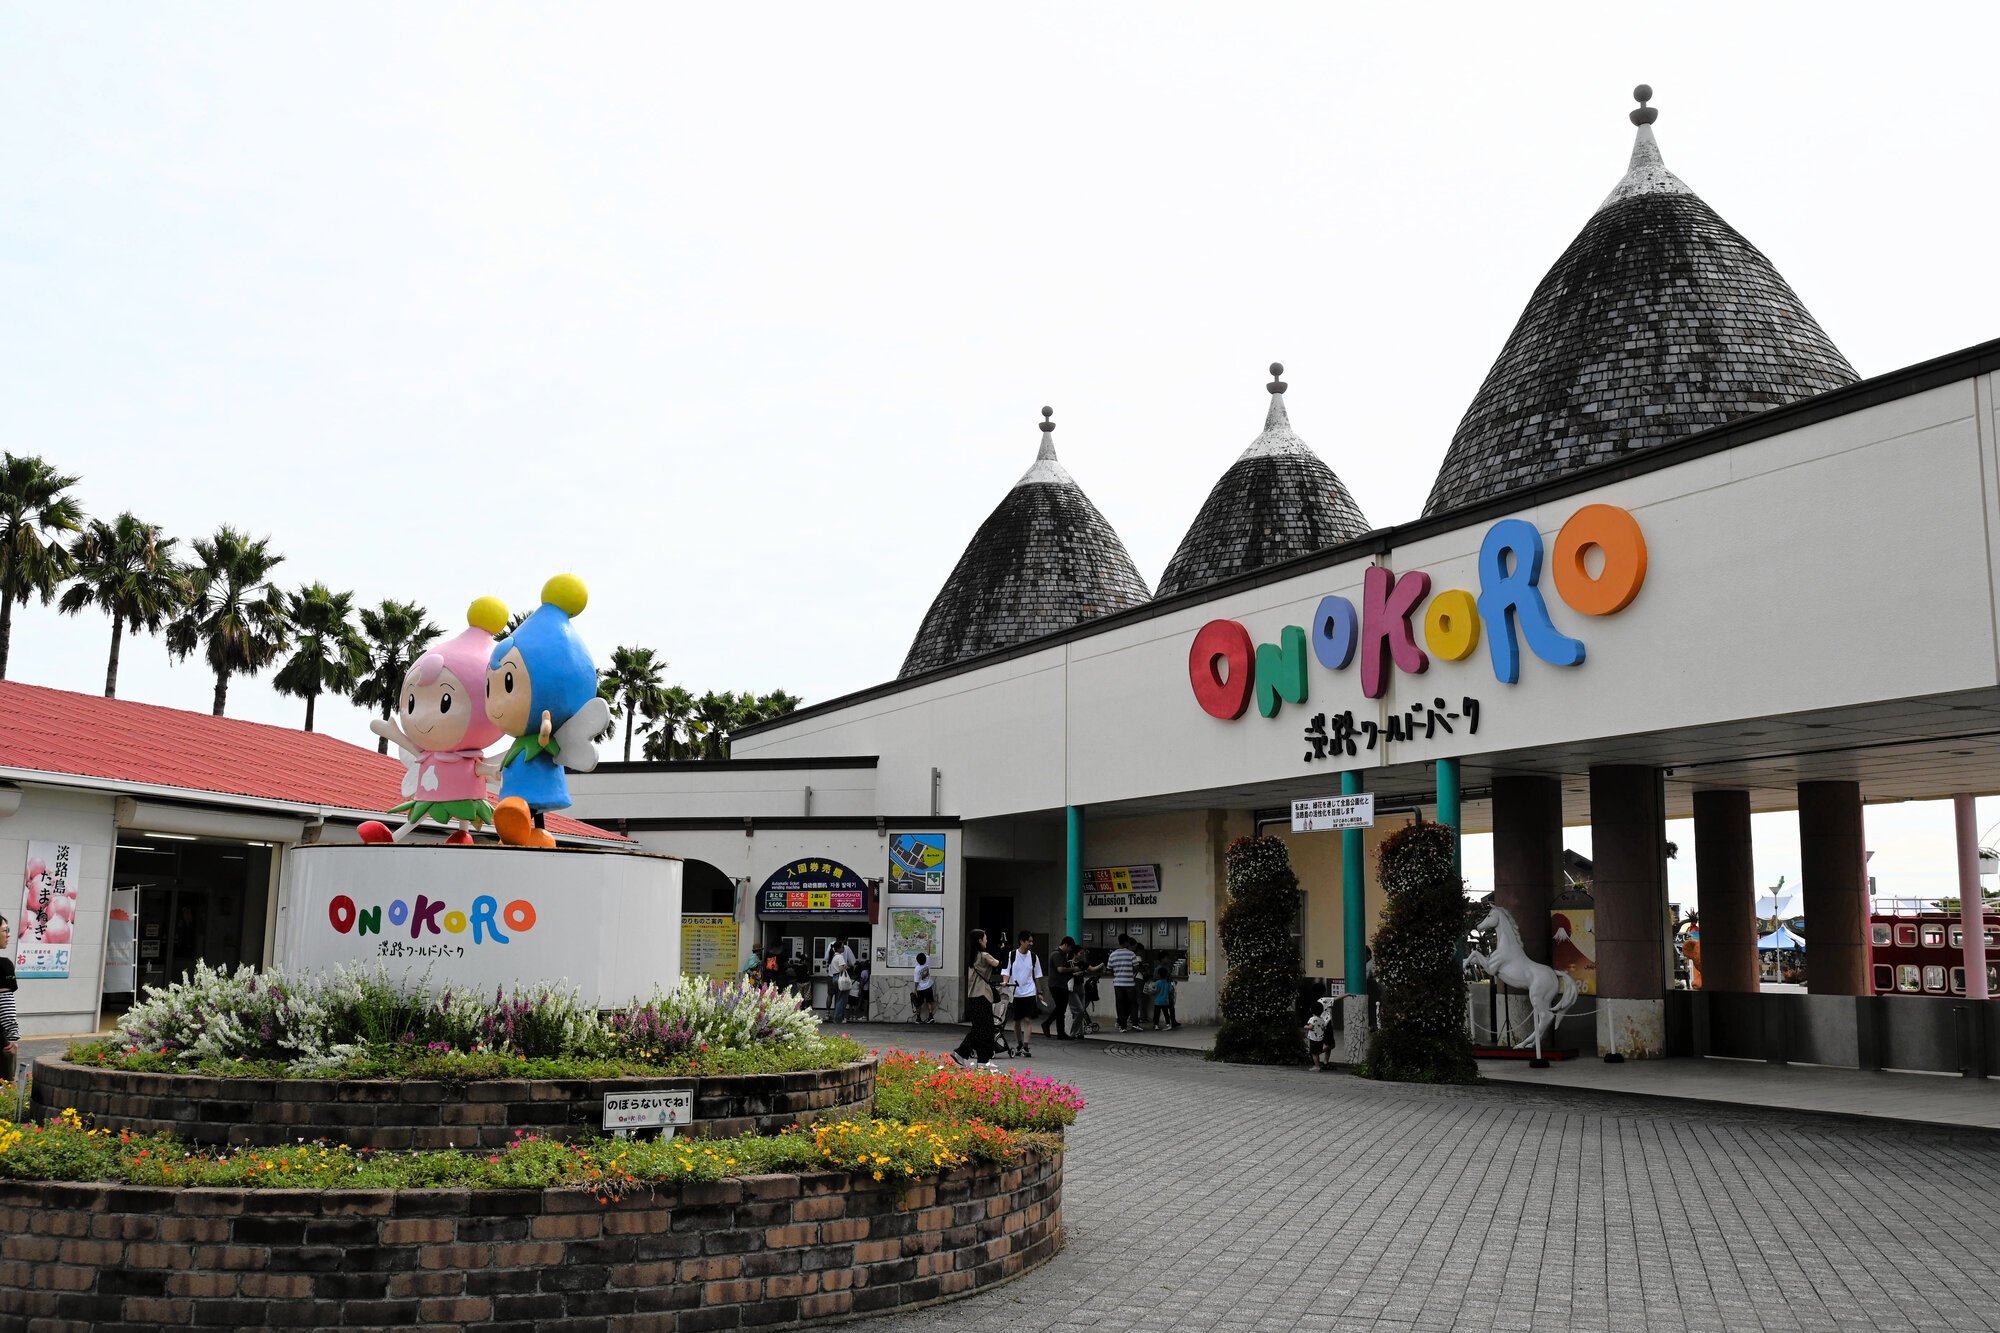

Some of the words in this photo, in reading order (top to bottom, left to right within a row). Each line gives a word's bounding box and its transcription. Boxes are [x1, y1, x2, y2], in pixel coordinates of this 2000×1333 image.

[1188, 503, 1648, 720] ONOKORO
[1303, 696, 1480, 762] 淡路ワールドパーク
[53, 844, 70, 894] 淡路島
[35, 870, 52, 941] たまねぎ
[328, 894, 537, 945] ONOKORO
[1087, 894, 1126, 906] Admission
[1127, 893, 1158, 905] Tickets
[377, 940, 465, 959] 淡路ワールドパーク
[607, 1096, 690, 1111] のぼらないでね!
